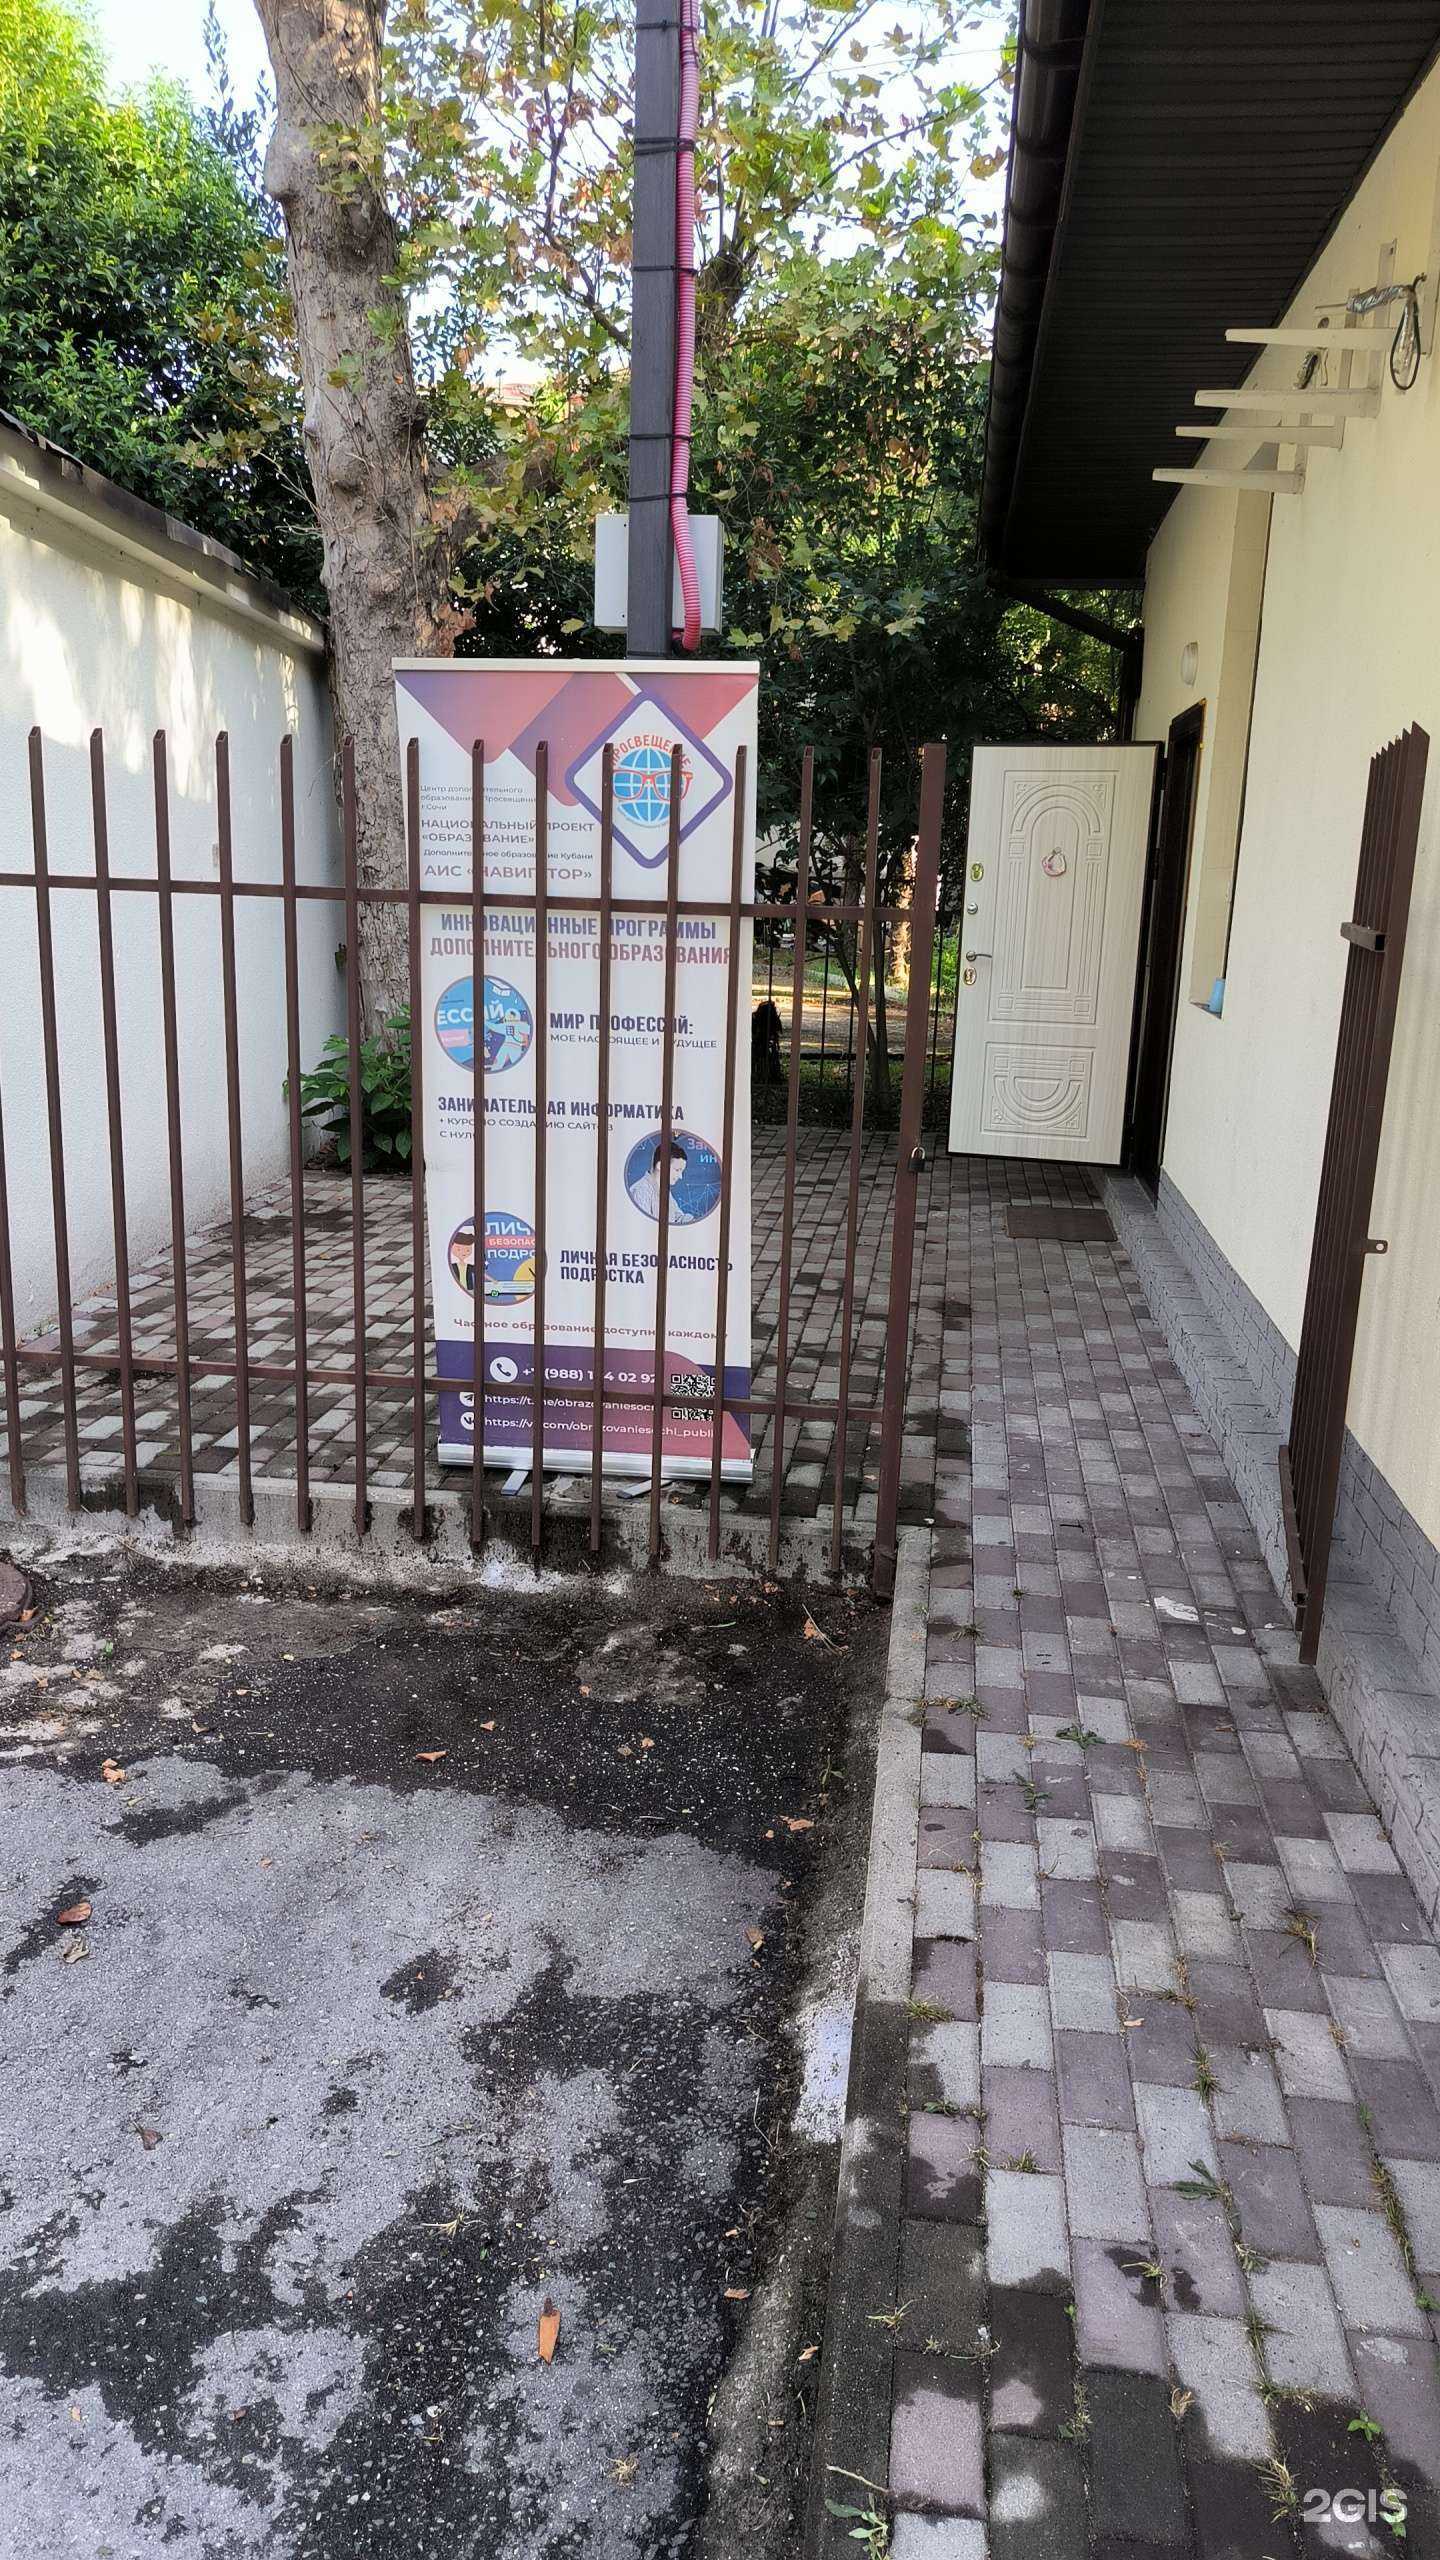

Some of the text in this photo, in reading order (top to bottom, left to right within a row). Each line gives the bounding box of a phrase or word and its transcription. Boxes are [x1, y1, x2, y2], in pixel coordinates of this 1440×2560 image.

[611, 734, 691, 767] РОСВЕЩЕЕ
[448, 785, 523, 794] допотельного
[421, 795, 474, 803] образовани
[421, 819, 537, 830] НАЦИОАЛЬНЫЙ
[422, 833, 535, 844] «ОБРАЗВАНИЕ»
[423, 849, 499, 857] Дополнитеное
[500, 850, 559, 860] образовие
[425, 864, 592, 881] АИС «НАВИГТОР»
[441, 913, 597, 936] ИННВАЦИННЫЕ
[430, 937, 731, 965] ДОПОНИТЕЬНОГО ОБРАЗВАНИЯ
[550, 1012, 694, 1035] МИР ПОФЕССЙ:
[551, 1034, 717, 1049] МОЕ НАСОЯЩЕЕ И ДУЩЕЕ
[438, 1096, 684, 1120] ЗАНИАТЕЛЬАЯ ИНФРМАТИА
[499, 1119, 565, 1129] СОЗДАИЮ
[567, 1122, 614, 1131] САЙТВ
[439, 1131, 448, 1139] С
[560, 1250, 733, 1271] ЛИЧНЯ БЕЗОАСНОСТ
[454, 1318, 728, 1340] Часное обрзовани доступн каждом
[544, 1367, 584, 1381] (988)
[587, 1370, 614, 1382] 14
[618, 1372, 638, 1384] 02
